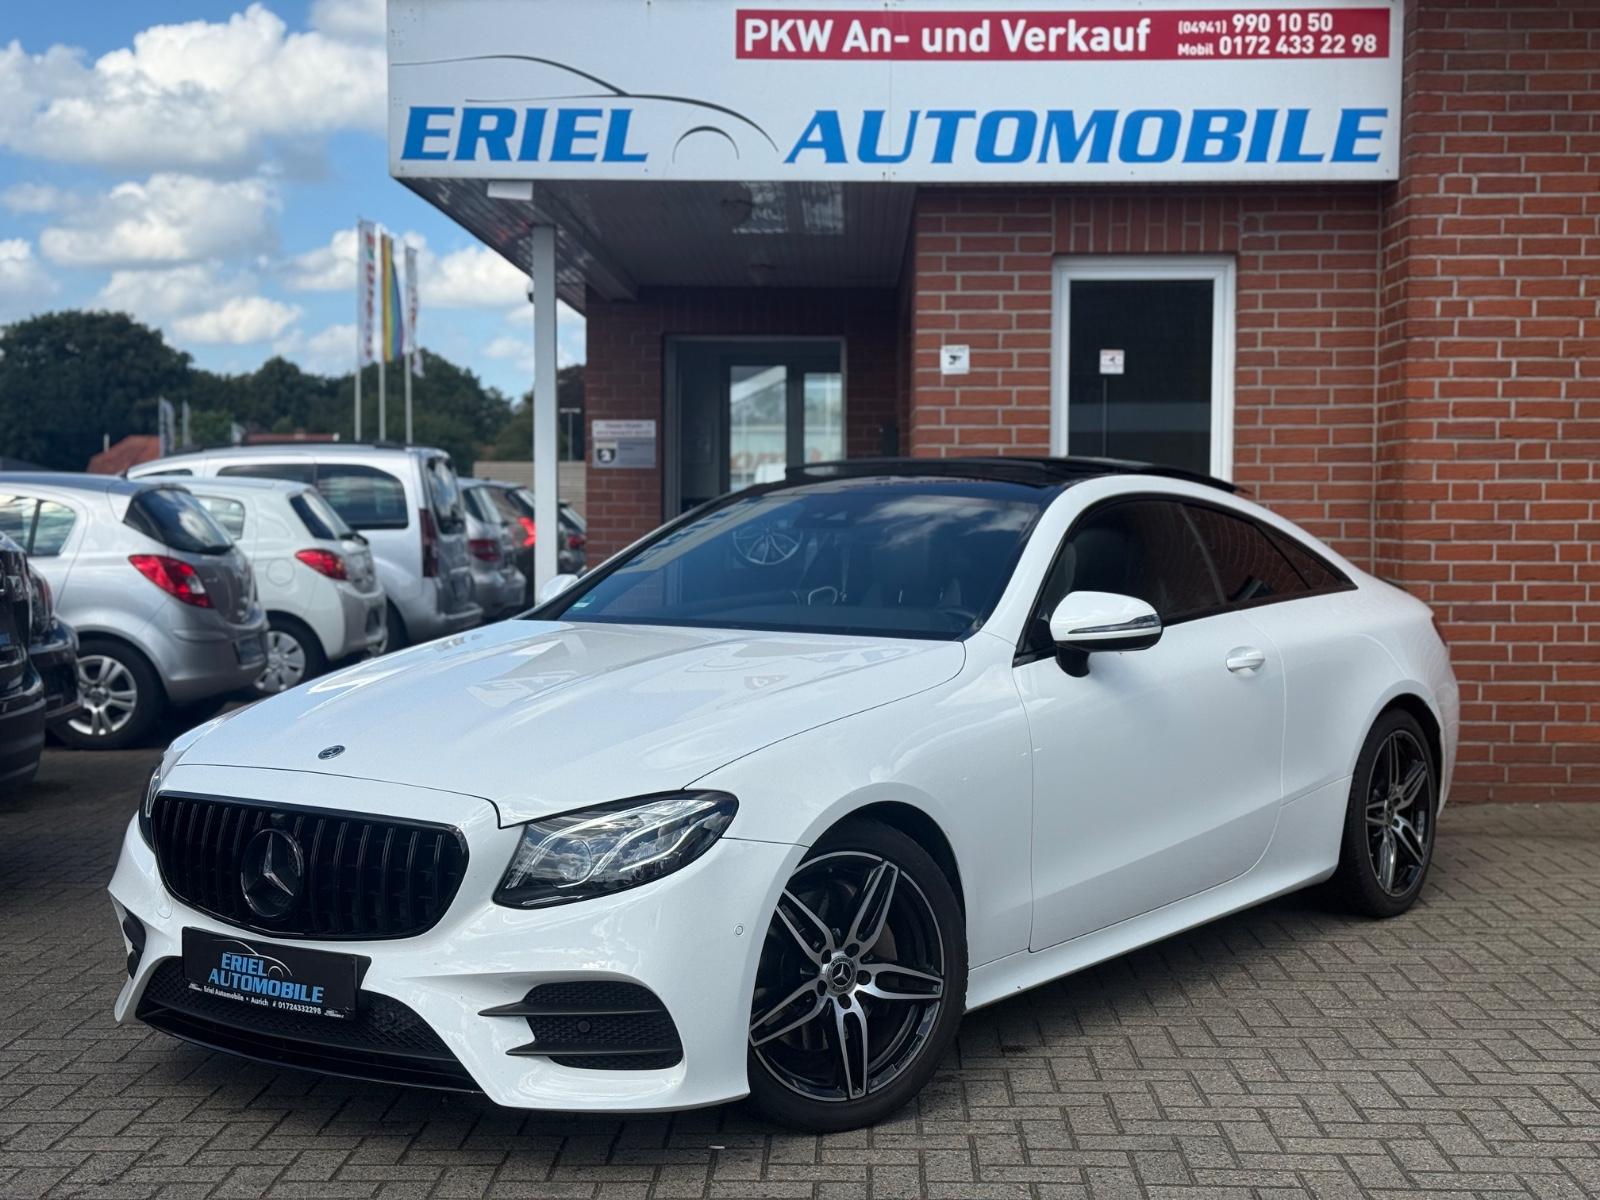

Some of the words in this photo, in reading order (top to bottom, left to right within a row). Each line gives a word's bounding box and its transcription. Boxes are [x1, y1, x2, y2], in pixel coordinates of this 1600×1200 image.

[744, 18, 834, 53] PKW
[842, 19, 910, 53] An-
[921, 19, 990, 53] und
[1001, 17, 1151, 53] Verkauf
[1178, 19, 1228, 35] (04941)
[1232, 13, 1271, 33] 990
[1277, 12, 1302, 33] 10
[1307, 12, 1333, 32] 50
[1177, 43, 1214, 56] Mobil
[1219, 35, 1271, 56] 0172
[1275, 34, 1315, 55] 433
[1320, 34, 1346, 54] 22
[1351, 34, 1377, 54] 98
[401, 106, 648, 163] ERIEL
[784, 108, 1388, 164] AUTOMOBILE
[221, 952, 268, 977] ERIEL
[208, 968, 324, 1003] AUTOMOBILE
[215, 988, 244, 1002] Automobile
